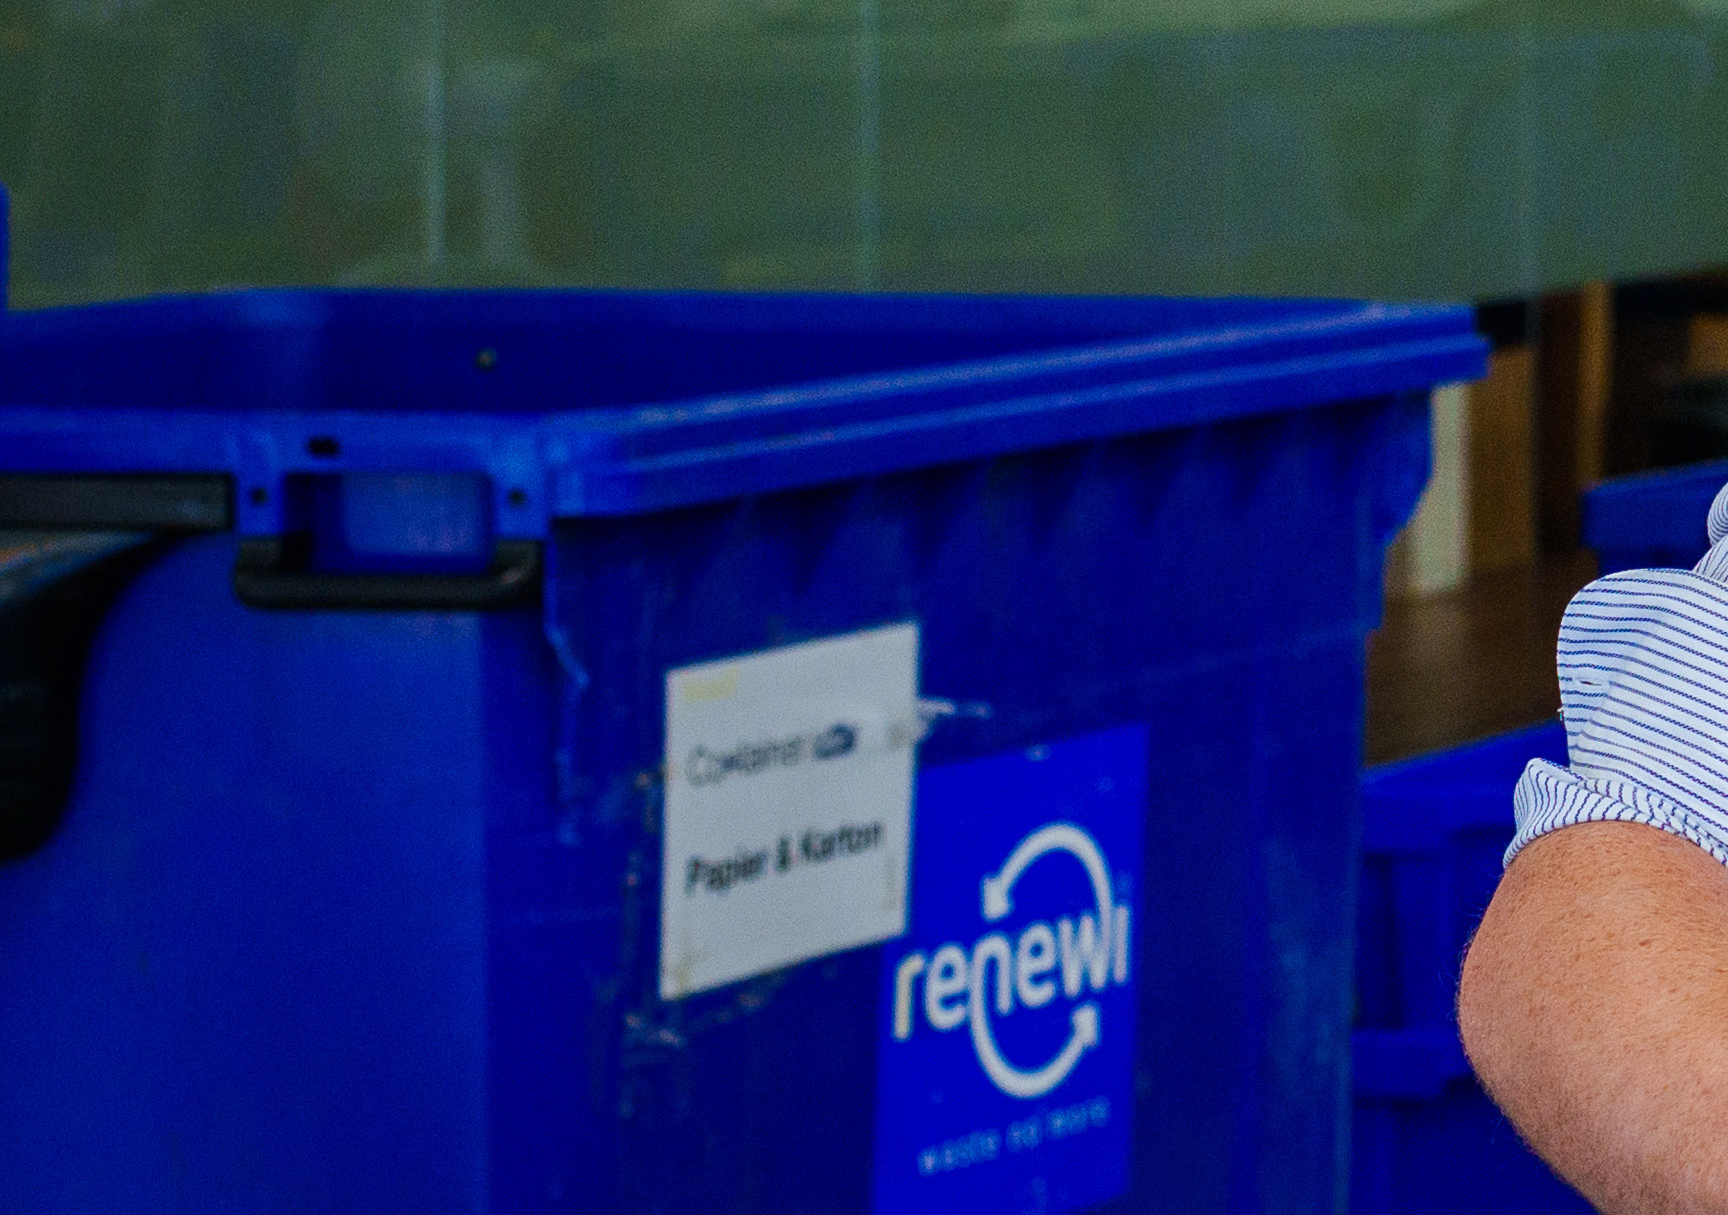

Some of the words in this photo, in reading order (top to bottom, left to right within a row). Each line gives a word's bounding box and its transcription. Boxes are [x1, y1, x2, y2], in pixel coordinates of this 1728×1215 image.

[684, 849, 768, 897] Papier
[774, 833, 793, 873] &
[801, 820, 884, 863] Karton
[892, 903, 1132, 1043] renewi
